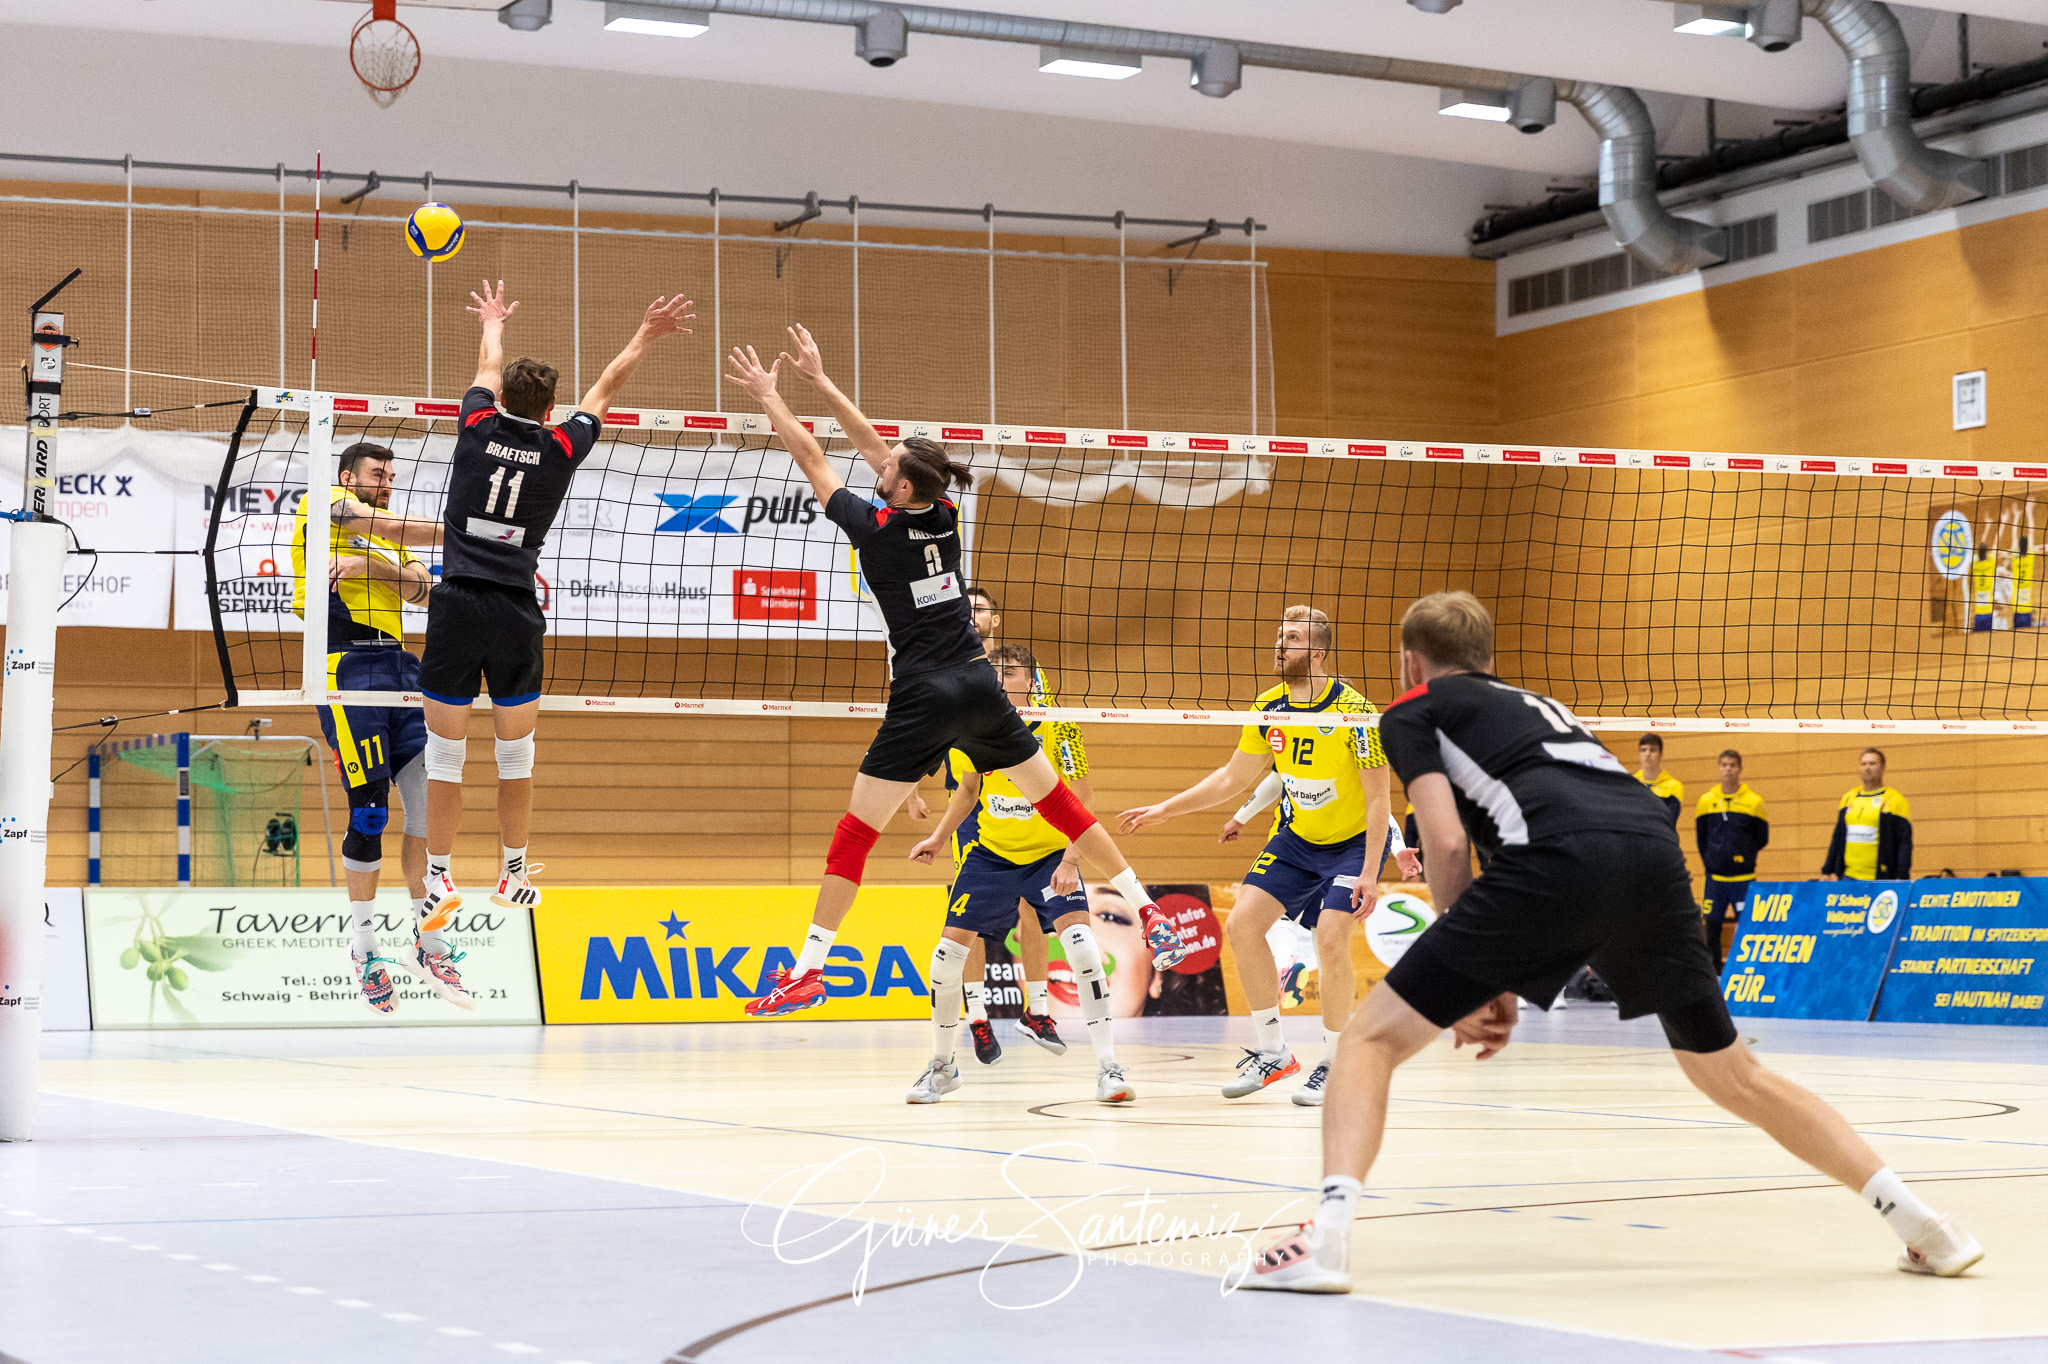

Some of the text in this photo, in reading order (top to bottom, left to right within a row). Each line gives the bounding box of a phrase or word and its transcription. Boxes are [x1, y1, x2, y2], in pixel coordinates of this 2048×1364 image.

[37, 394, 52, 430] PORT
[485, 441, 541, 466] BRAETSCH
[33, 438, 49, 513] ERARD
[55, 474, 106, 496] ECK
[204, 485, 308, 514] MEYS
[485, 466, 525, 518] 11
[54, 501, 108, 522] mpen
[742, 486, 819, 533] puls
[761, 585, 806, 597] Sparkasse
[218, 598, 295, 613] SERVIC
[761, 598, 804, 611] Nürnberg
[11, 660, 36, 671] Zapf
[360, 734, 384, 769] 11
[1292, 737, 1314, 765] 12
[4, 829, 28, 839] Zapf
[1248, 850, 1277, 875] 12
[950, 893, 970, 916] 4
[1751, 893, 1793, 922] WIR
[1950, 890, 2021, 908] EMOTIONEN
[1177, 924, 1198, 940] nter
[1910, 925, 1972, 942] TRADITION
[222, 937, 277, 949] GREEK
[1736, 934, 1817, 963] STEHEN
[984, 962, 1026, 982] ream
[1935, 957, 2035, 975] PARTNERSCHAFT
[281, 975, 317, 986] Tel.:
[222, 990, 292, 1003] Schwaig
[489, 988, 508, 999] 21
[984, 987, 1023, 1005] eam
[1951, 991, 2012, 1008] HAUTNAH
